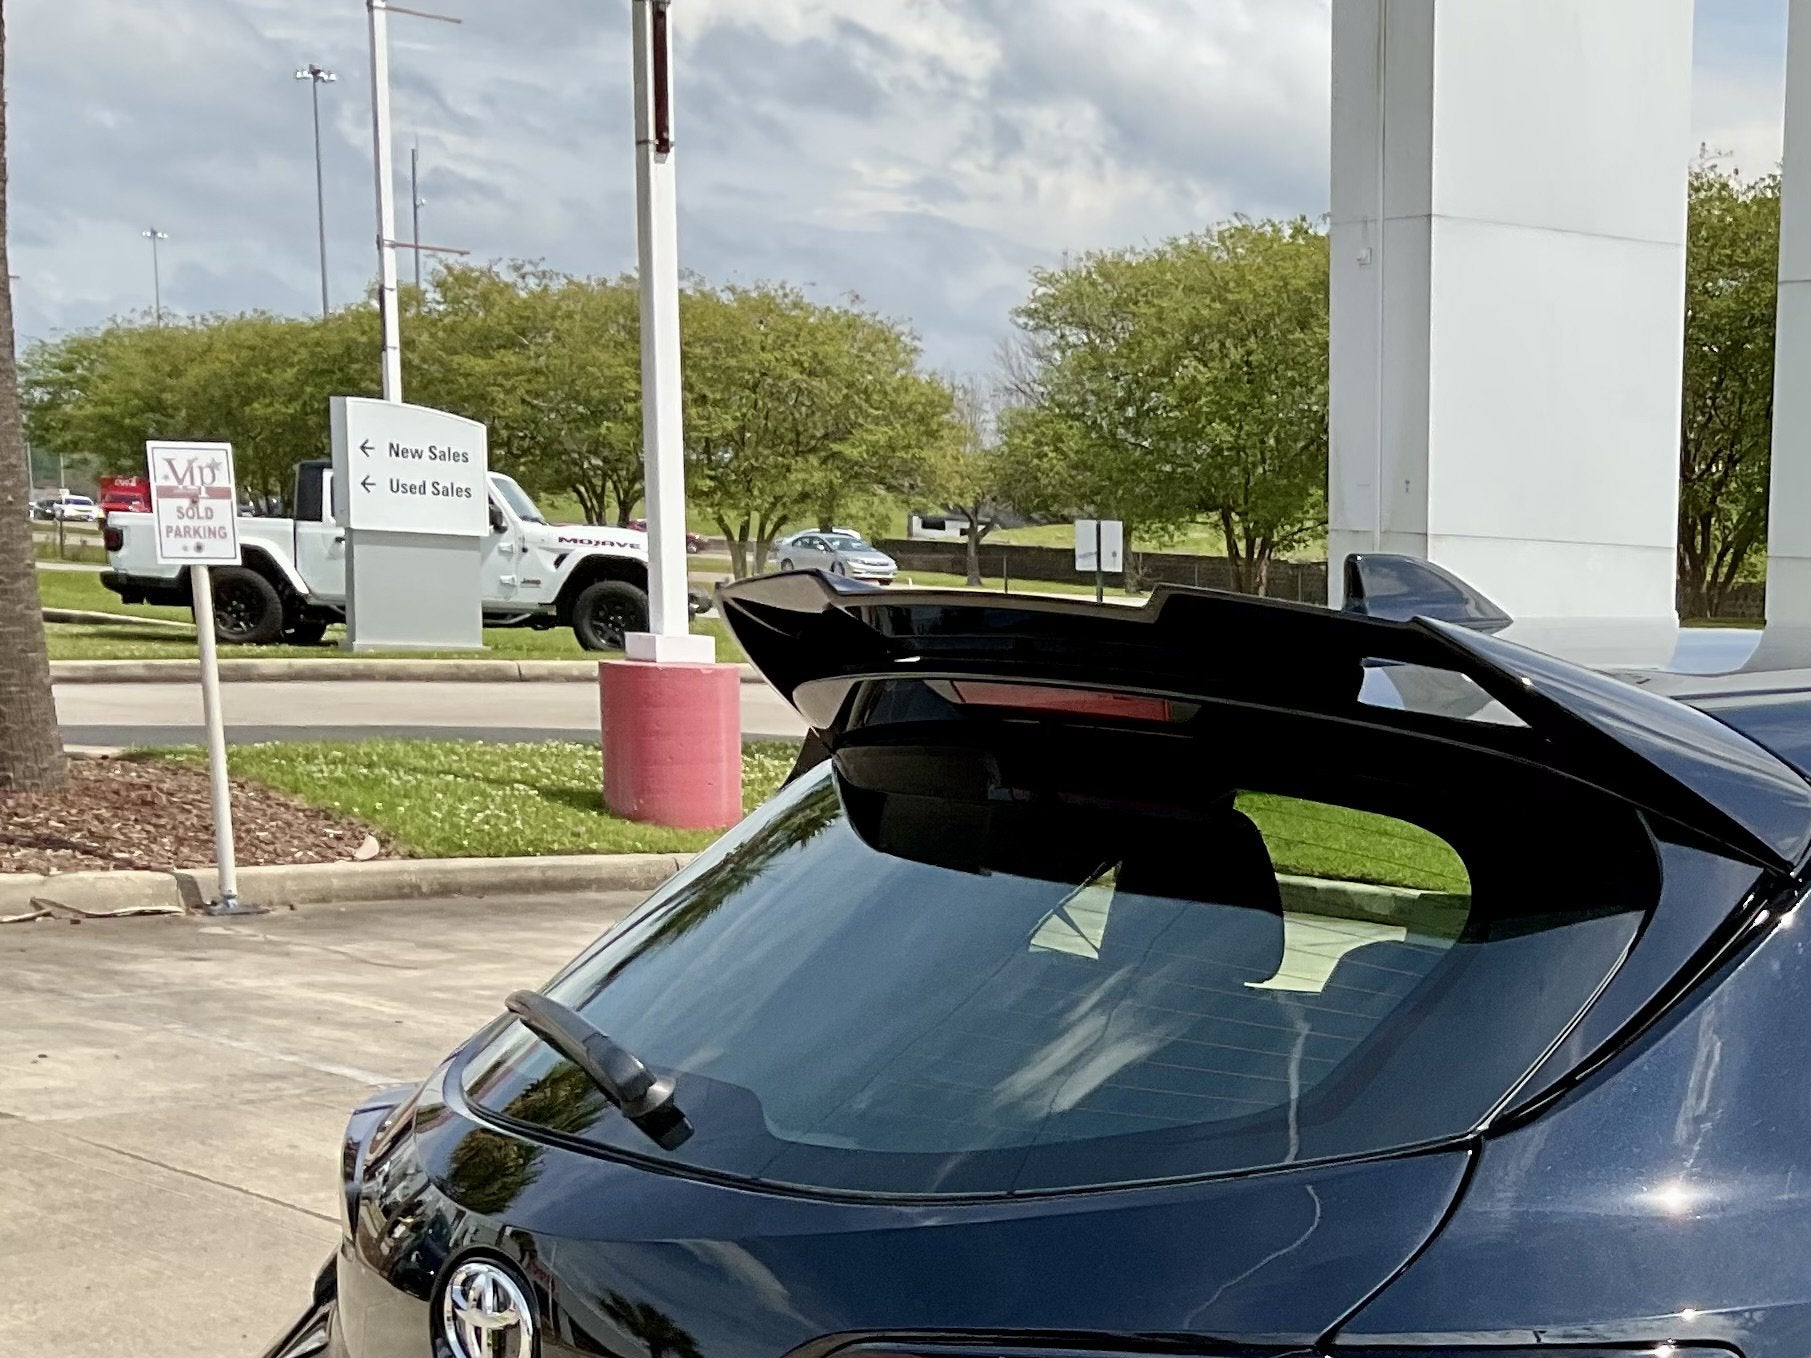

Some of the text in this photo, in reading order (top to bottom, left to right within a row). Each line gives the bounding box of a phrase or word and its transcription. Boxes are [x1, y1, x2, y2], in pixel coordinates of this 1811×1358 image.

[388, 442, 470, 463] New Sales
[389, 478, 473, 499] Used Sales
[176, 506, 214, 520] SOLD
[165, 525, 228, 539] PARKING
[558, 536, 641, 549] MOJAVE
